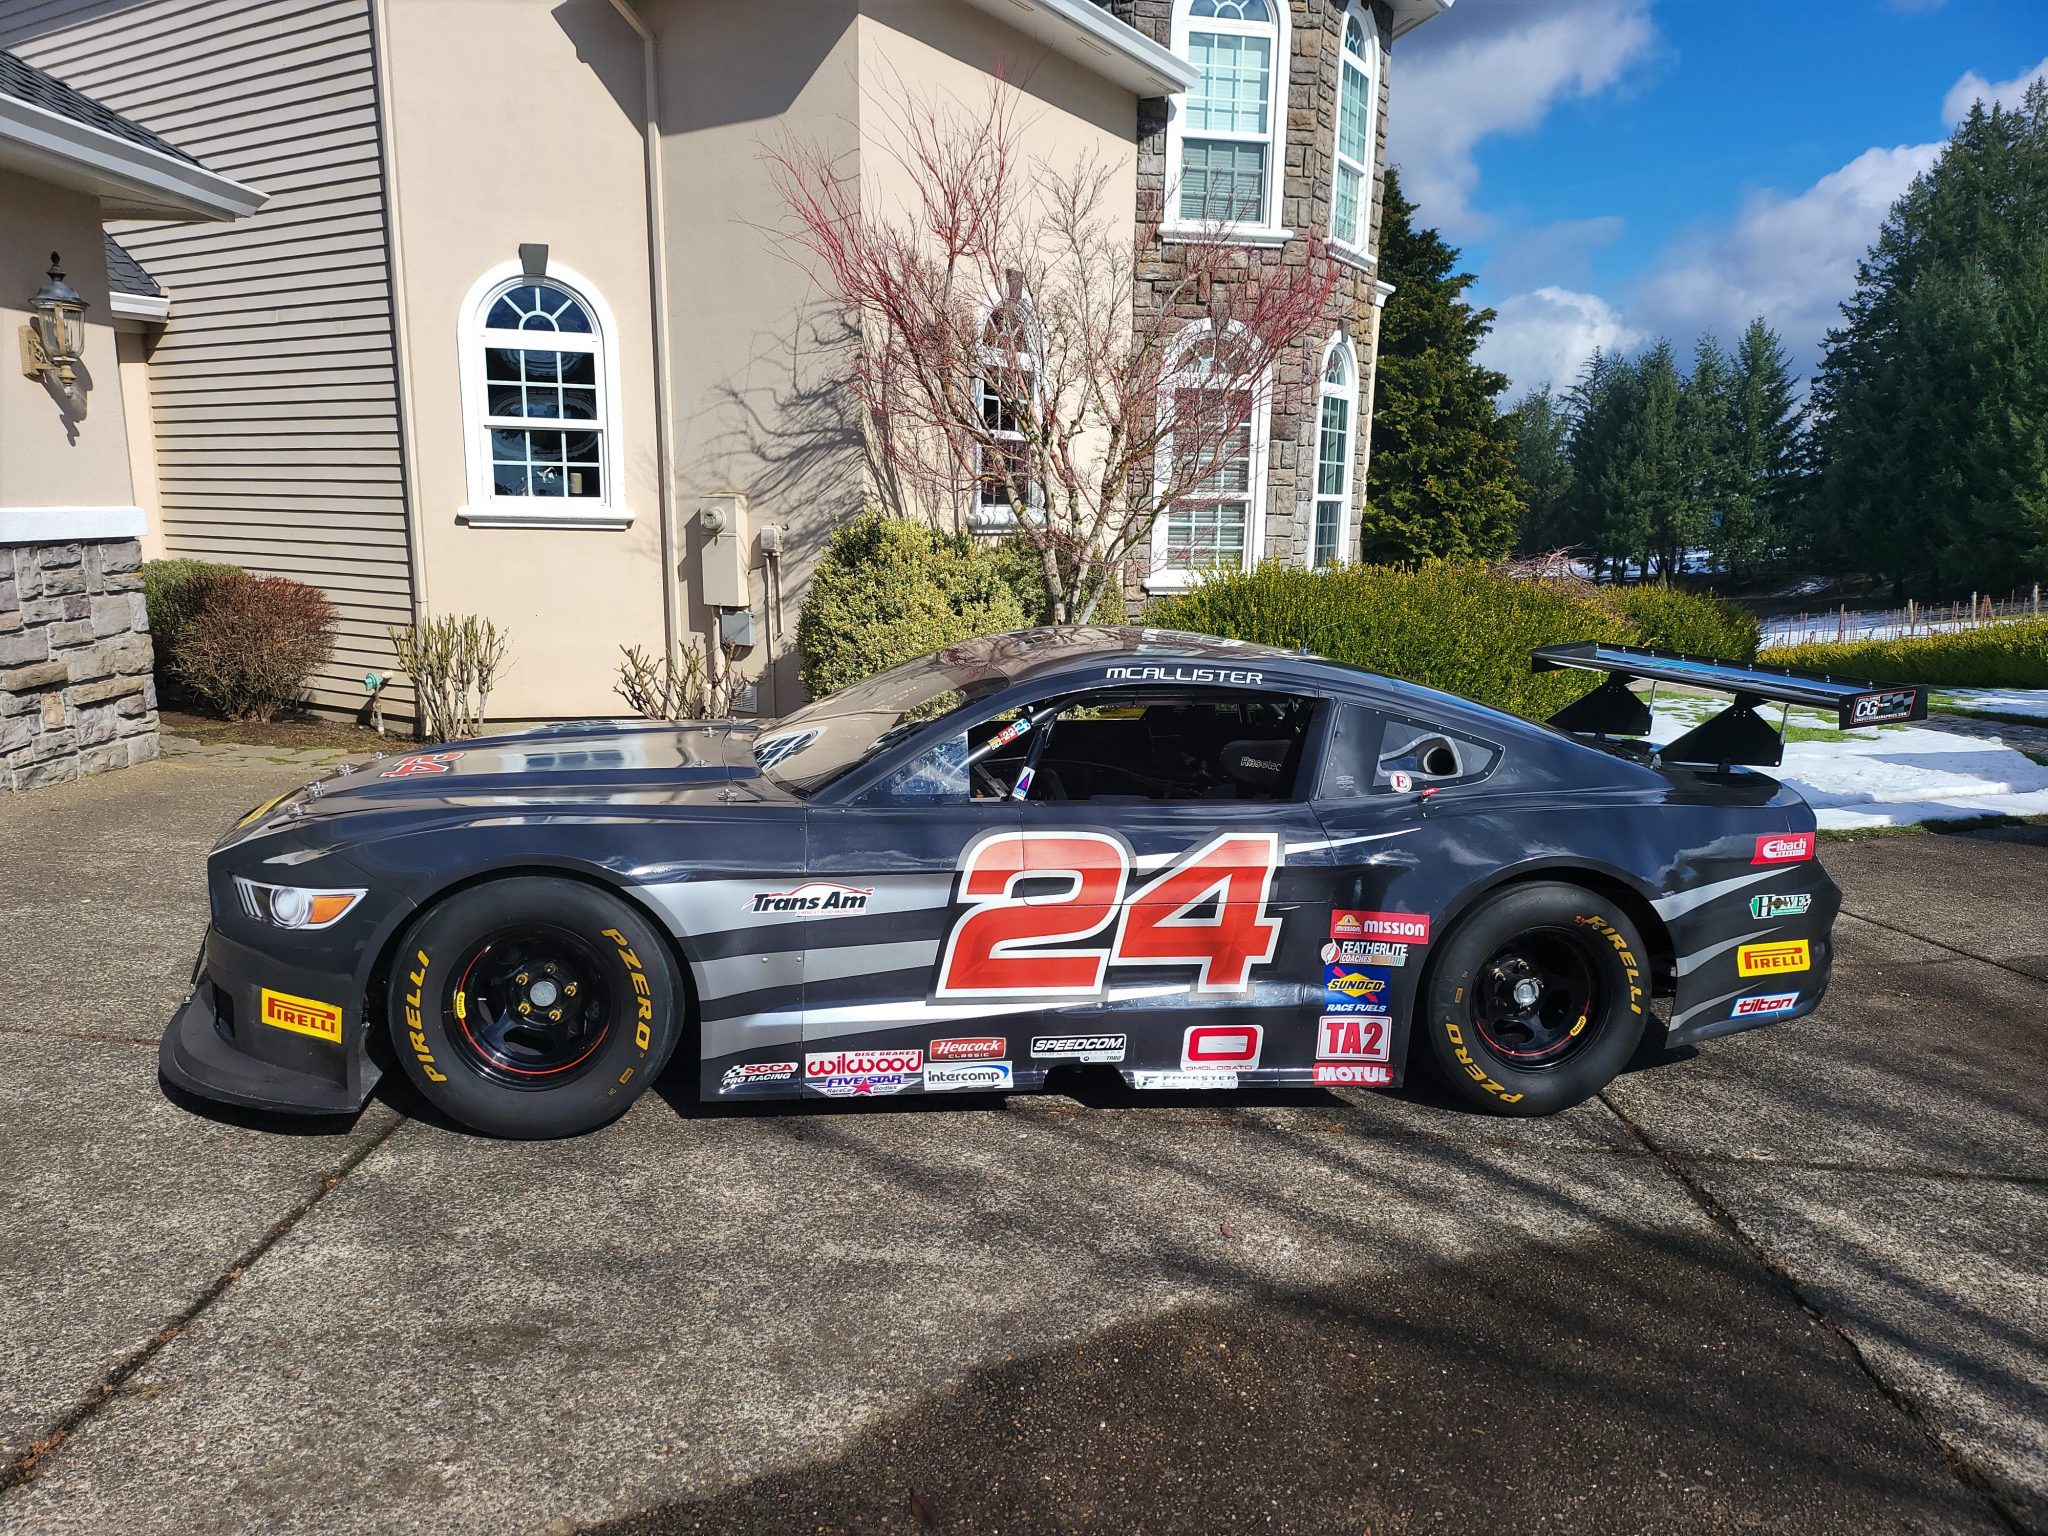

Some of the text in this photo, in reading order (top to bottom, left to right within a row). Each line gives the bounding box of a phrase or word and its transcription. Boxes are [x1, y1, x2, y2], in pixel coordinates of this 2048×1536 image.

[1106, 667, 1263, 685] MCALLISTER
[1856, 700, 1879, 717] CG
[1395, 775, 1408, 788] E
[1763, 838, 1807, 858] Eibach
[752, 891, 867, 912] Trans Am
[936, 832, 1282, 997] 24
[1341, 941, 1409, 956] FEATHERLITE
[1340, 954, 1373, 963] COACHES
[1585, 915, 1642, 1015] PIRELLI
[1744, 947, 1804, 969] PIRELLI
[1329, 980, 1384, 991] SUNOCO
[1327, 1003, 1387, 1013] RACE FUELS
[1738, 998, 1793, 1013] tilton
[268, 997, 336, 1034] PIRELLI
[405, 950, 448, 1081] PIRELLI
[1326, 1021, 1384, 1056] TA2
[934, 1040, 1002, 1054] Heacock
[744, 1063, 793, 1074] SCCA
[807, 1050, 922, 1076] wilwood
[722, 1073, 792, 1085] PRO RACING
[826, 1074, 903, 1087] FIVE STAR
[1318, 1066, 1391, 1082] MOTUL
